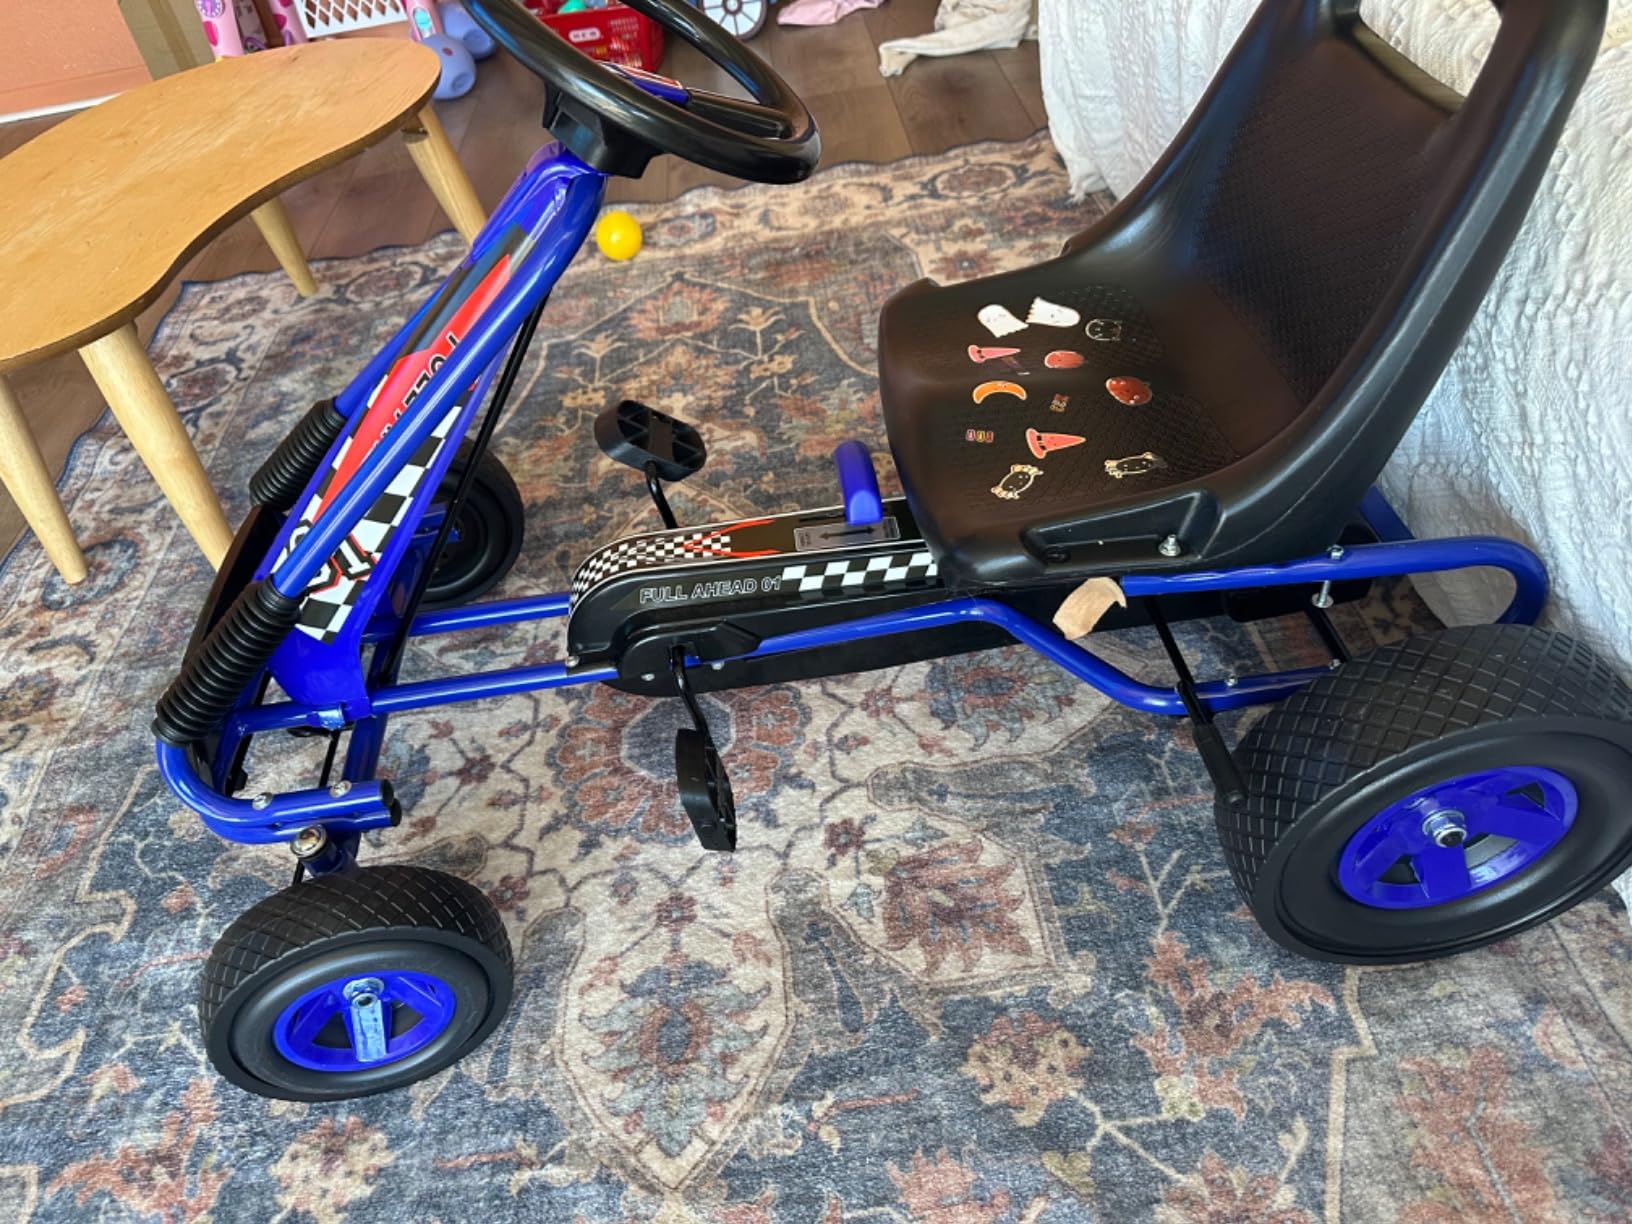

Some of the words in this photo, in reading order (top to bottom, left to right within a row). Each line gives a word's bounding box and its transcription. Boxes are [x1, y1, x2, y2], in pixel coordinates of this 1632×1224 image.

[639, 585, 688, 604] FULL
[691, 577, 757, 599] AHEAD
[760, 575, 782, 592] 01
